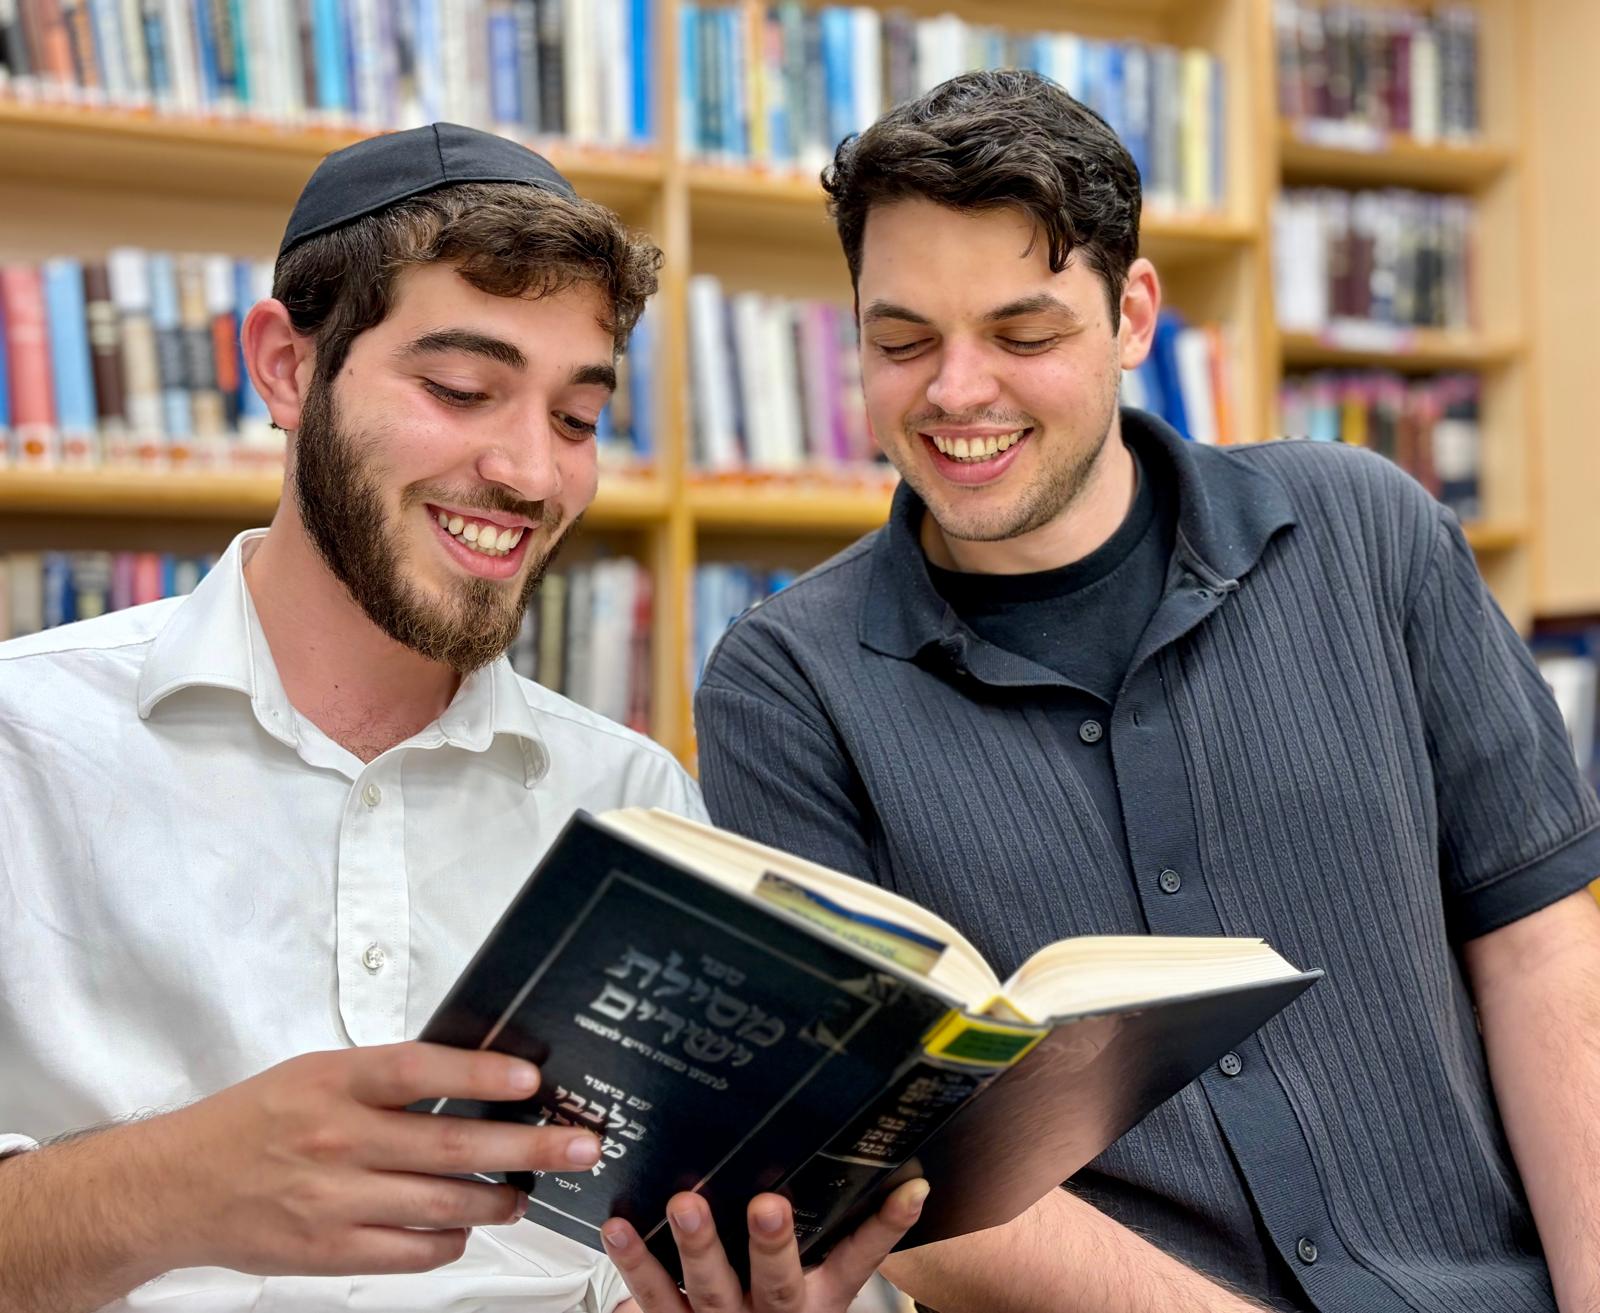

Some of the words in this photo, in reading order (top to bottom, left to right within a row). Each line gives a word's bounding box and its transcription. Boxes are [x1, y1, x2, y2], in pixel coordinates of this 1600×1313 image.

[589, 982, 753, 1067] ישרים
[605, 946, 786, 1047] מסילת
[556, 1085, 647, 1141] בלבבי
[584, 1074, 625, 1099] ביאור
[626, 1094, 653, 1111] עם
